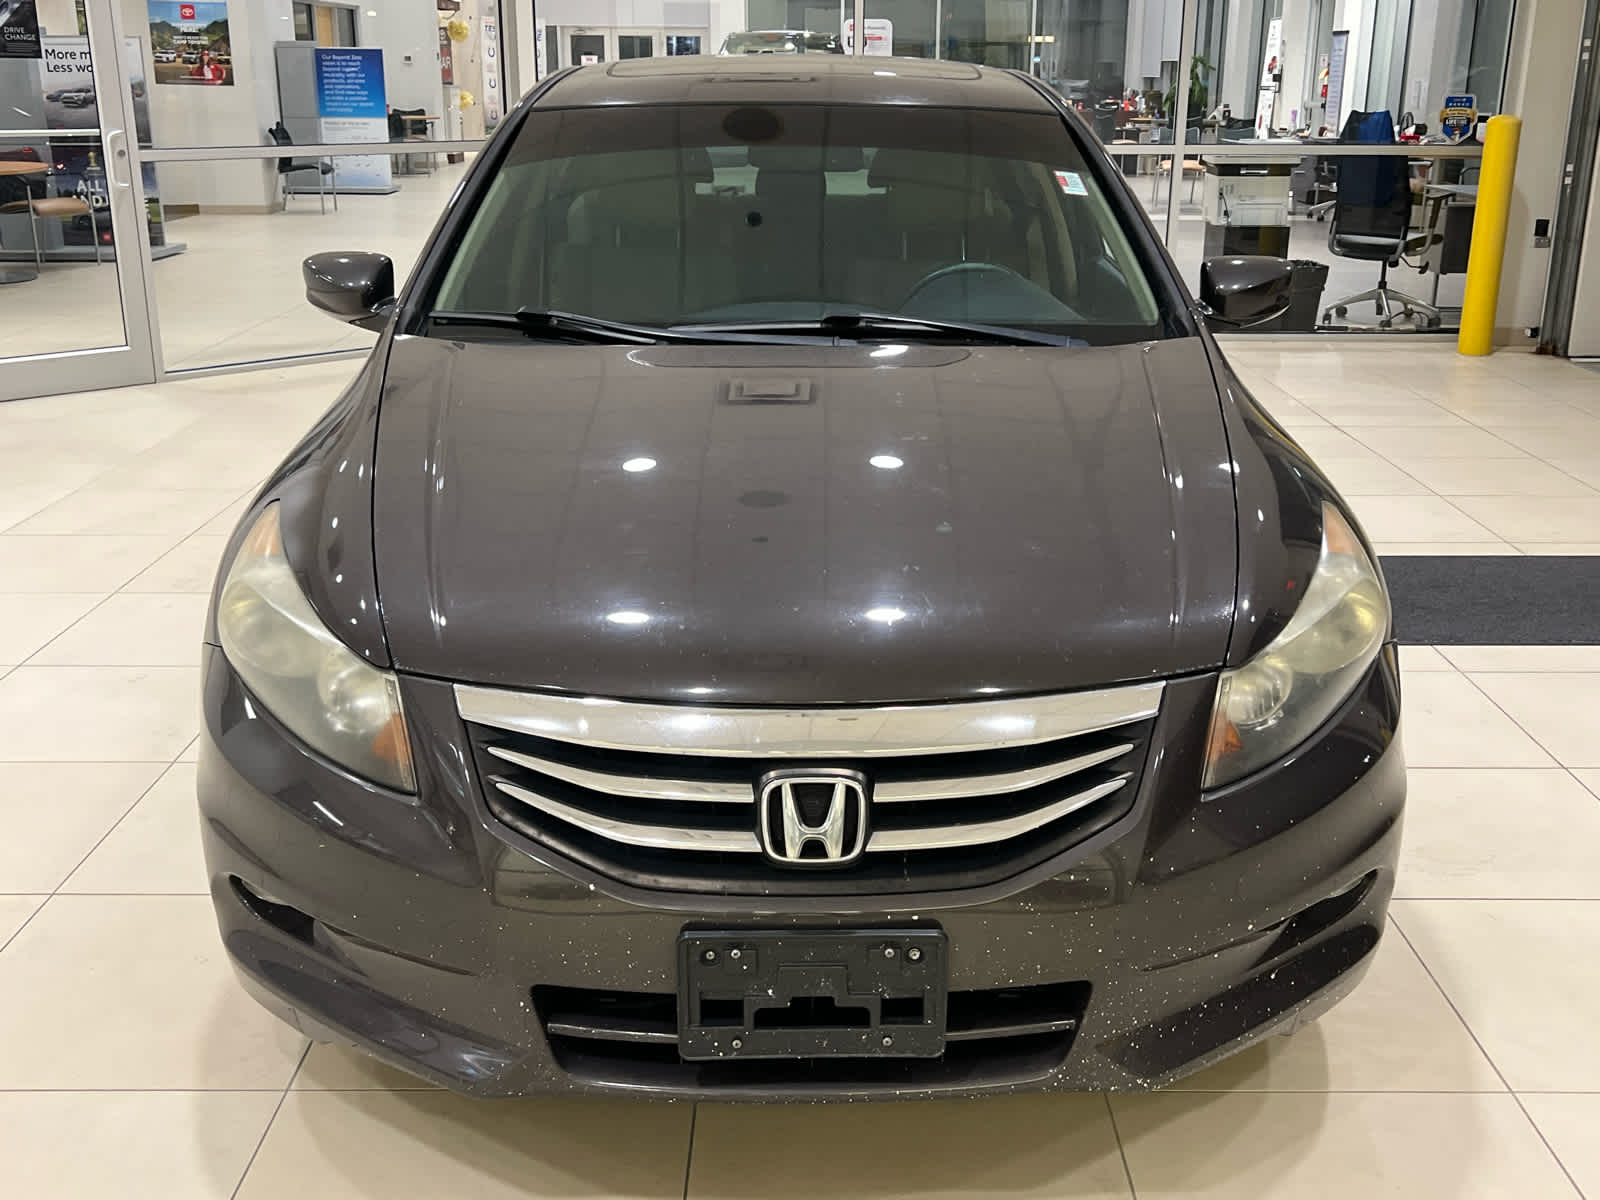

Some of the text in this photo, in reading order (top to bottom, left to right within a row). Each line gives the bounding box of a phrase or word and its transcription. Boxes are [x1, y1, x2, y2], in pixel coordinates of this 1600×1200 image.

[4, 33, 36, 41] CHANGE
[45, 48, 77, 60] More
[47, 61, 73, 73] Less
[77, 179, 104, 194] ALL
